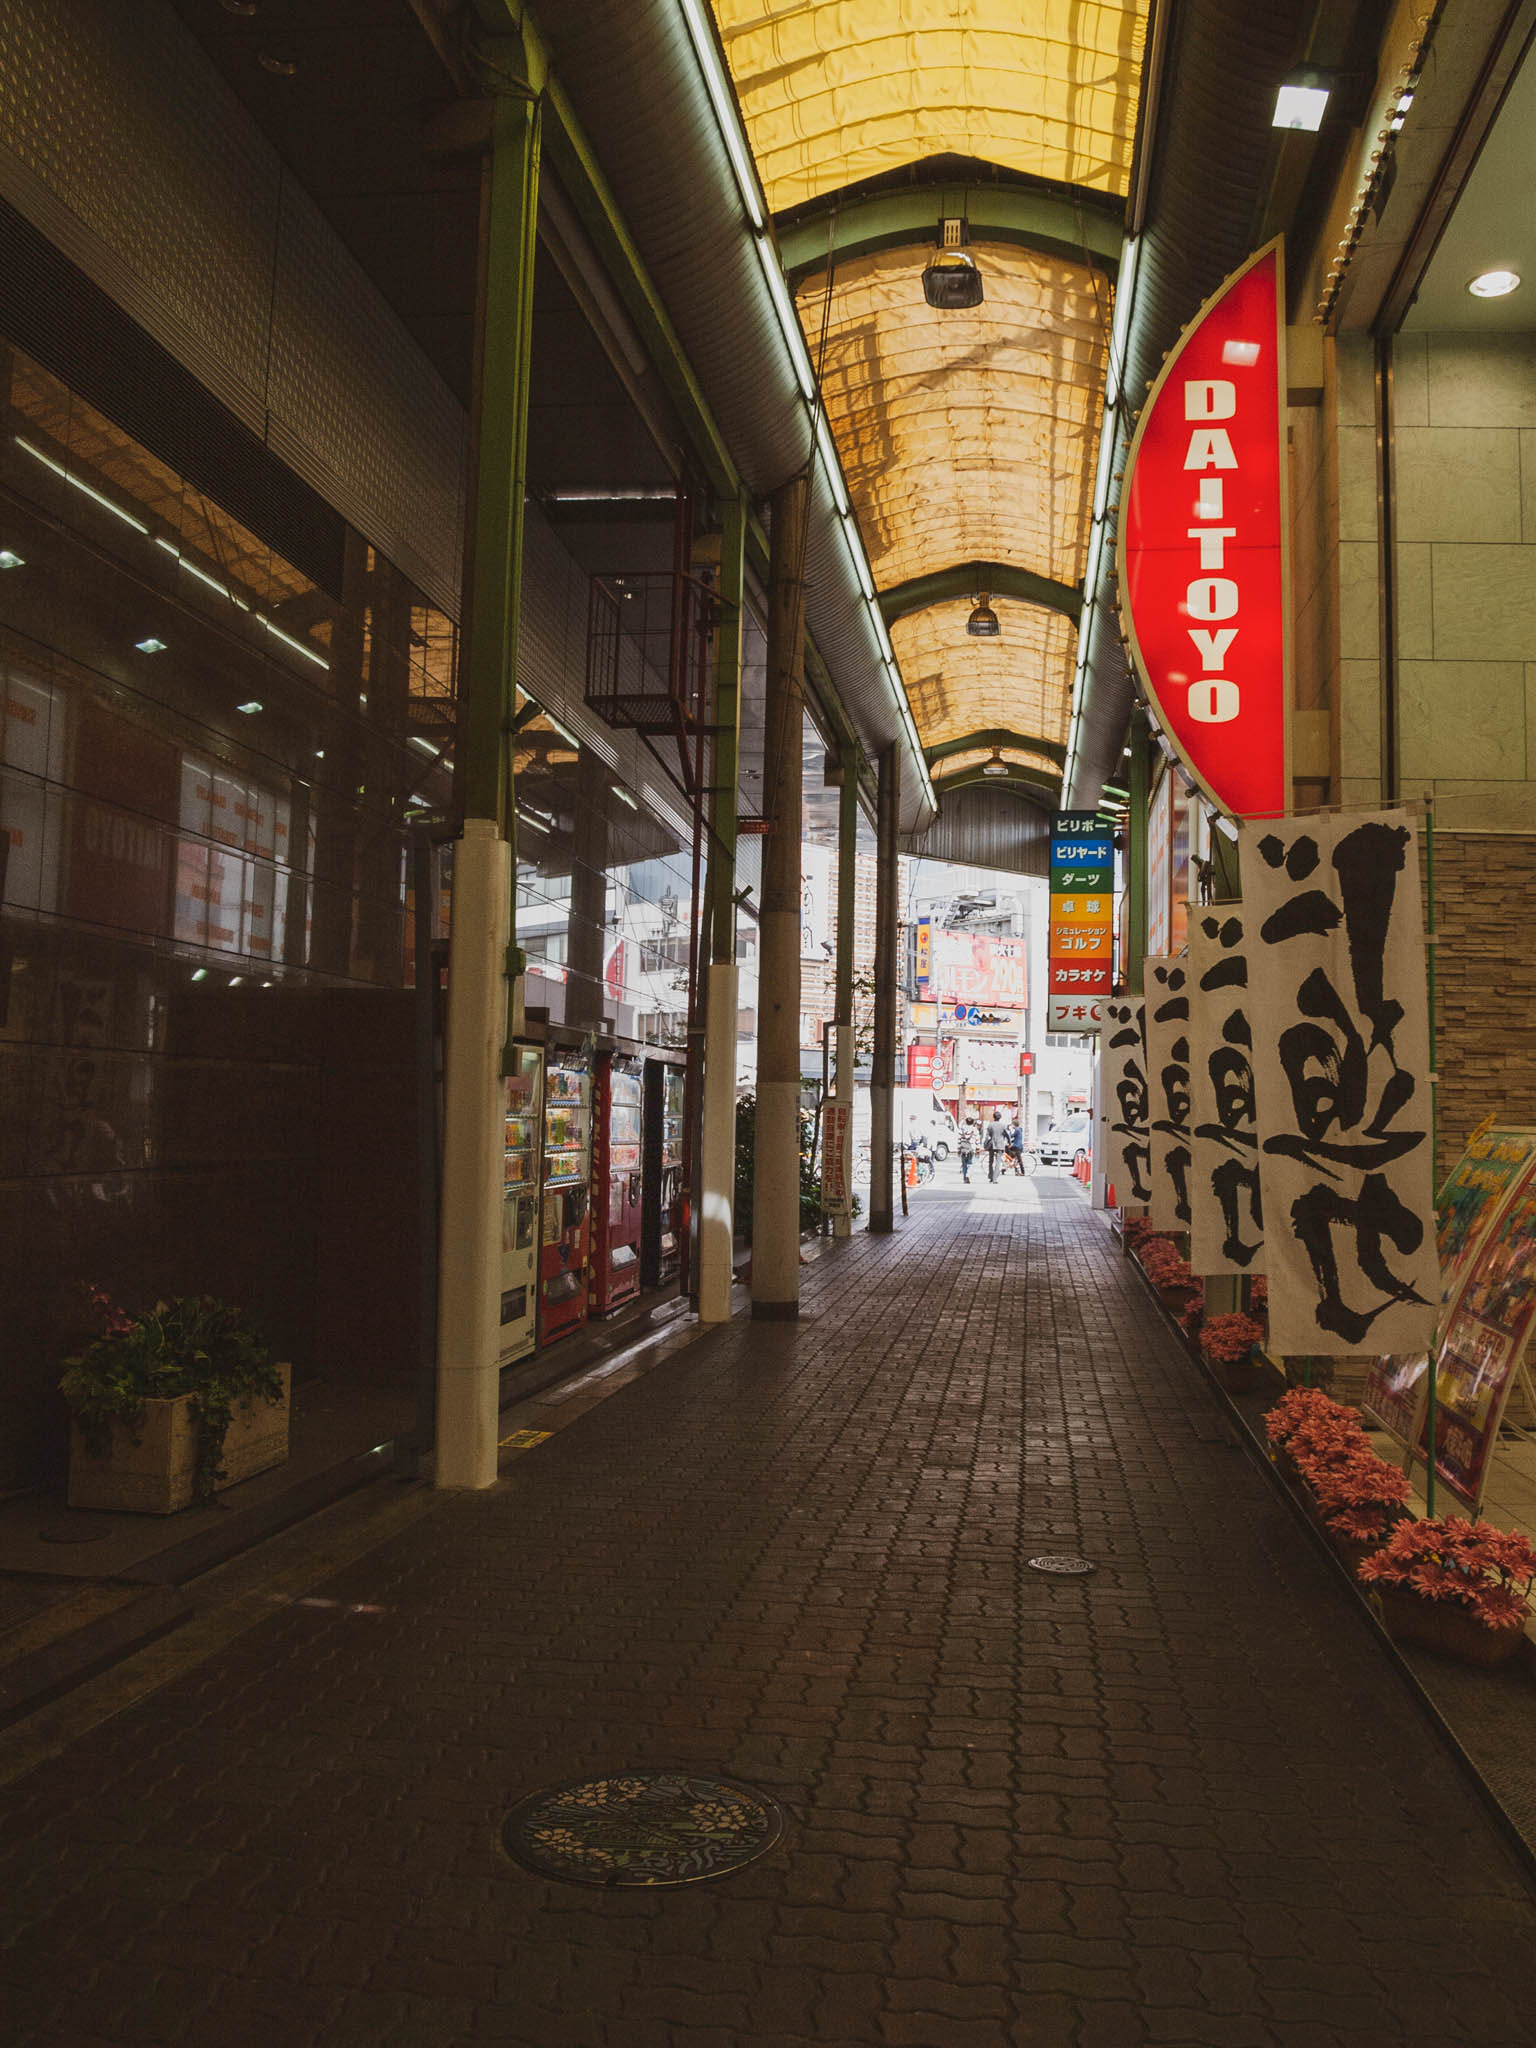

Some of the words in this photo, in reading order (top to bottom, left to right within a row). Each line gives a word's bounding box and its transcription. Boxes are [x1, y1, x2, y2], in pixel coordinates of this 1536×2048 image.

[1184, 379, 1240, 723] DAITOYO
[1057, 820, 1108, 832] ビリボー
[1056, 846, 1107, 859] ビリヤード
[1062, 873, 1100, 886] ダーツ
[1056, 927, 1106, 935] シミュレーション
[1061, 937, 1101, 950] ゴルフ
[1056, 968, 1106, 982] カラオケ
